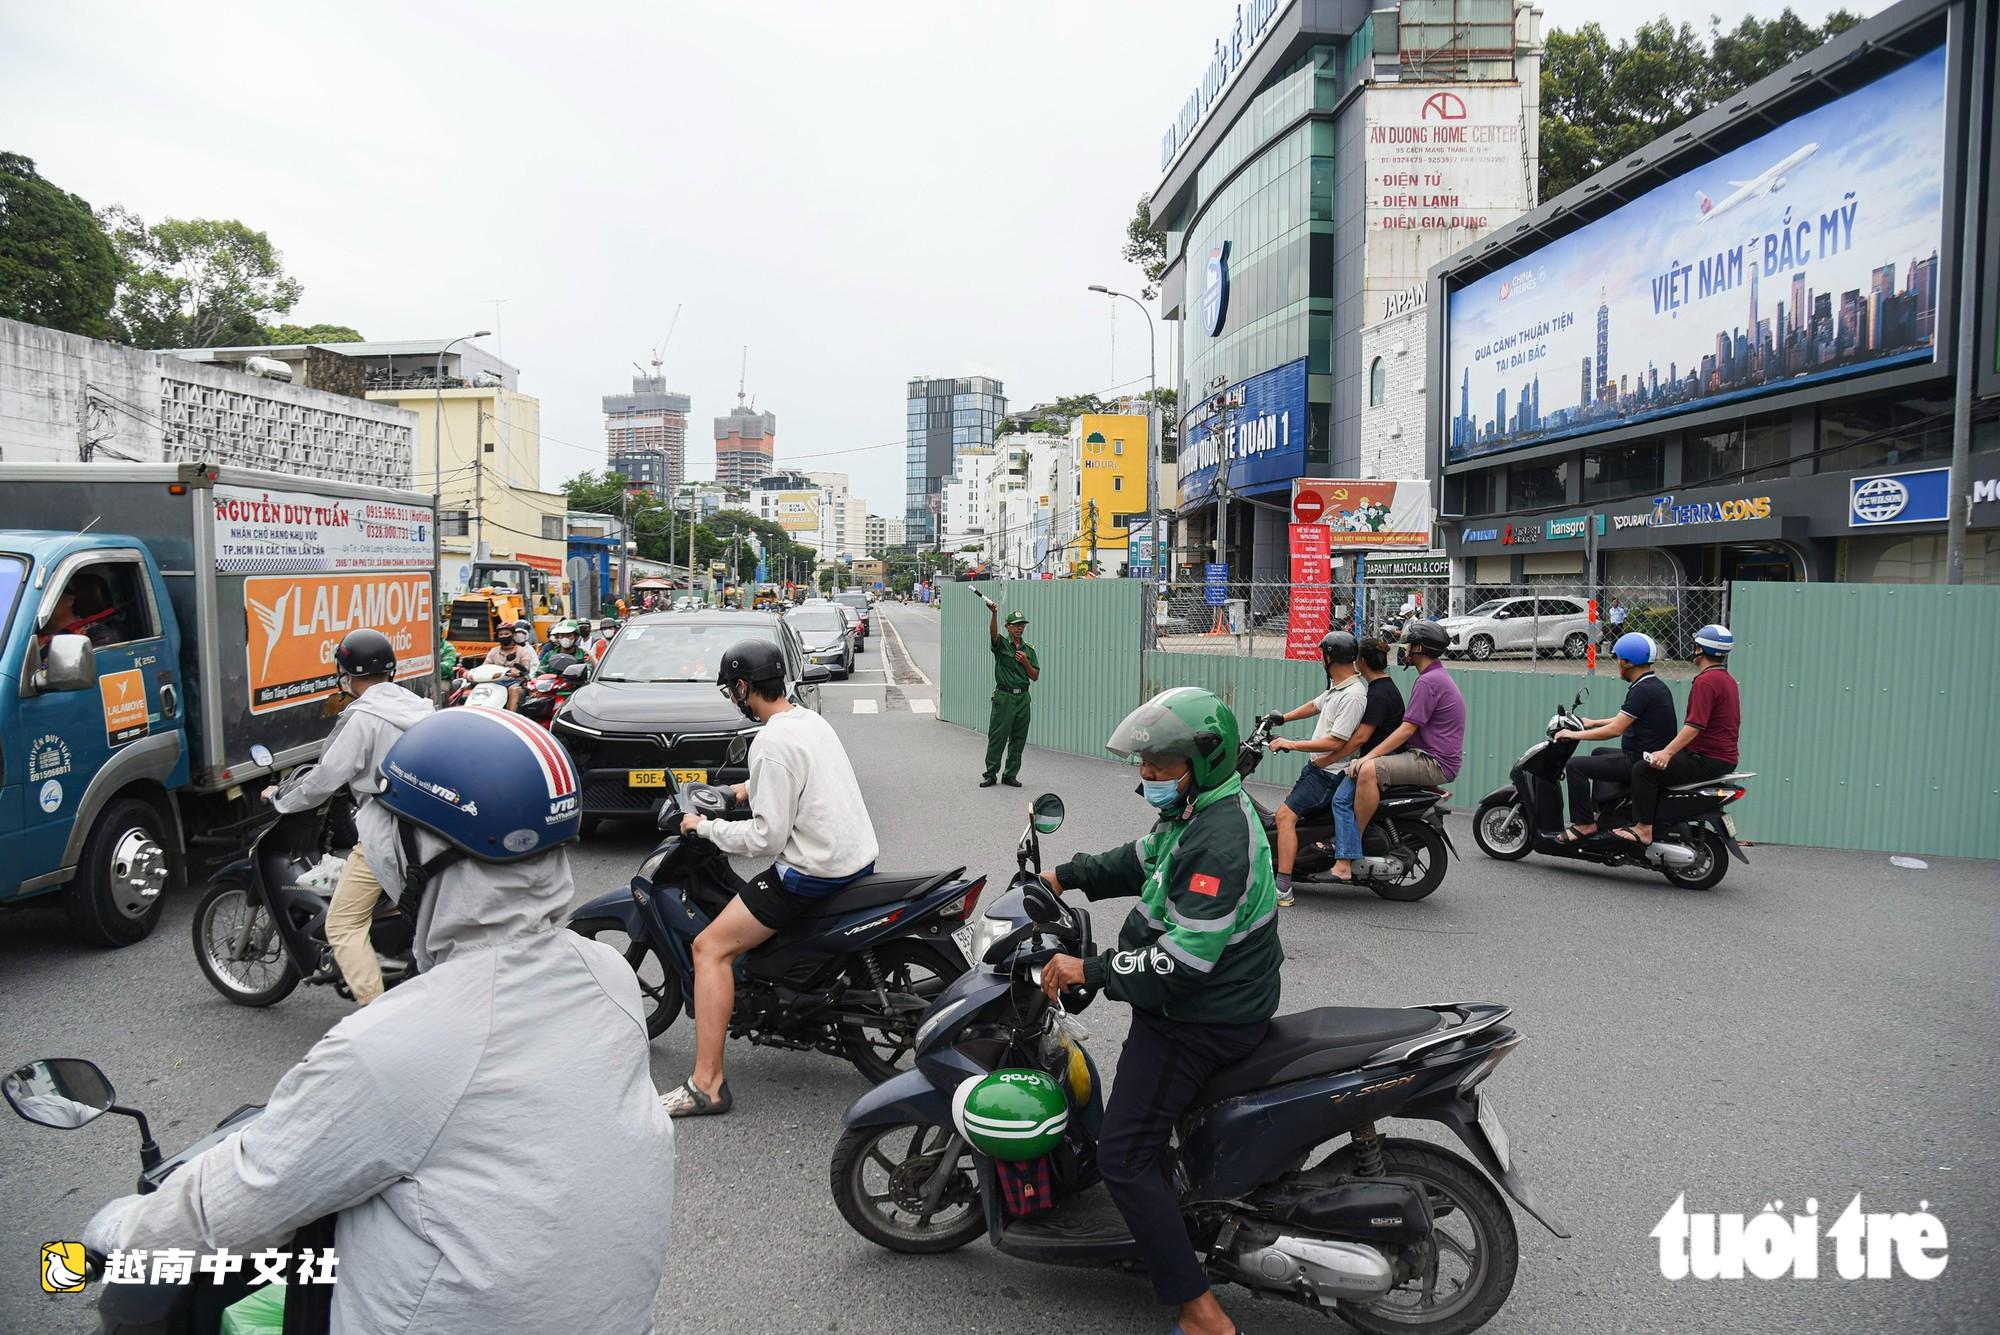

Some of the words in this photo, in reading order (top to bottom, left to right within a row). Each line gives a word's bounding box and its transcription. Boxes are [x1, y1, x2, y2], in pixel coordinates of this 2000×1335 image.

[1433, 126, 1468, 143] HOME
[1472, 126, 1518, 143] CENTER
[1382, 171, 1419, 189] ĐIỆN
[1382, 193, 1418, 209] ĐIỆN
[1422, 195, 1459, 209] LẠNH
[1421, 216, 1446, 229] GIA
[1651, 259, 1693, 319] VIỆT
[1698, 244, 1743, 300] NAM
[1764, 205, 1811, 278] BẮC
[1819, 191, 1858, 260] MỸ
[1512, 270, 1533, 286] CHINA
[1383, 281, 1428, 320] JAPAN
[1474, 343, 1492, 361] QUÁ
[1518, 320, 1550, 344] THUẬN
[1551, 312, 1574, 334] TIỆN
[1496, 360, 1509, 376] TẠI
[1511, 353, 1527, 371] ĐÀI
[1527, 342, 1547, 363] BẮC
[1224, 413, 1236, 460] TẾ
[1239, 411, 1277, 459] QUẬN
[1281, 410, 1290, 446] 1
[215, 493, 281, 523] NGUYỄN
[284, 504, 312, 526] DUY
[315, 501, 349, 527] TUẤN
[1671, 496, 1771, 525] TERRACONS
[1551, 519, 1587, 537] hansgro
[223, 545, 254, 555] TP.HCM
[254, 543, 264, 555] VÀ
[266, 543, 280, 555] CÁC
[1394, 562, 1422, 574] MATCHA
[1423, 562, 1429, 573] &
[292, 581, 430, 637] LALAMOVE
[134, 656, 156, 668] K250
[107, 699, 145, 716] LALAMOVE
[1112, 946, 1175, 975] Grb
[1000, 1073, 1041, 1086] Grab
